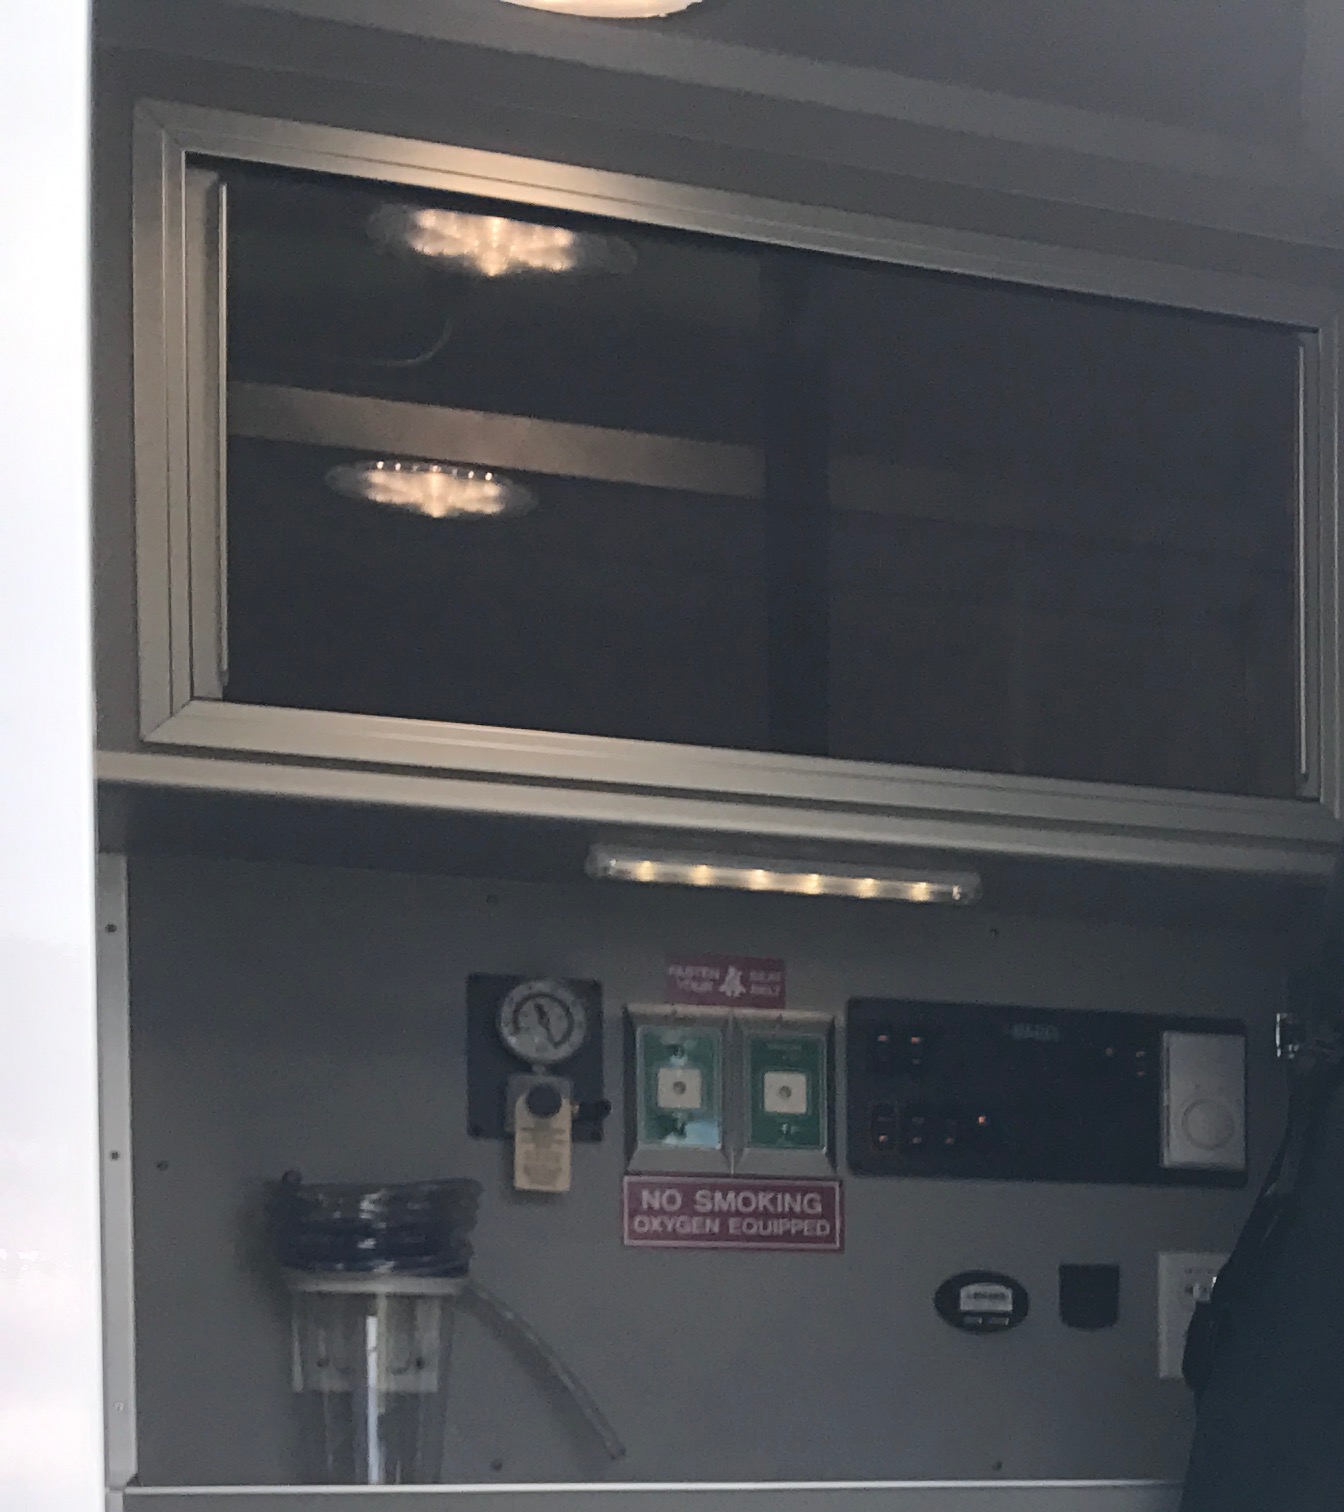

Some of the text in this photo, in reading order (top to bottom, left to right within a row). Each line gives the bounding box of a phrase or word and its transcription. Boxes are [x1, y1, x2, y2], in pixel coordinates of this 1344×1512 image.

[641, 1188, 823, 1214] NO SMOKING
[632, 1214, 830, 1237] OXYGEN EQUIPPED
